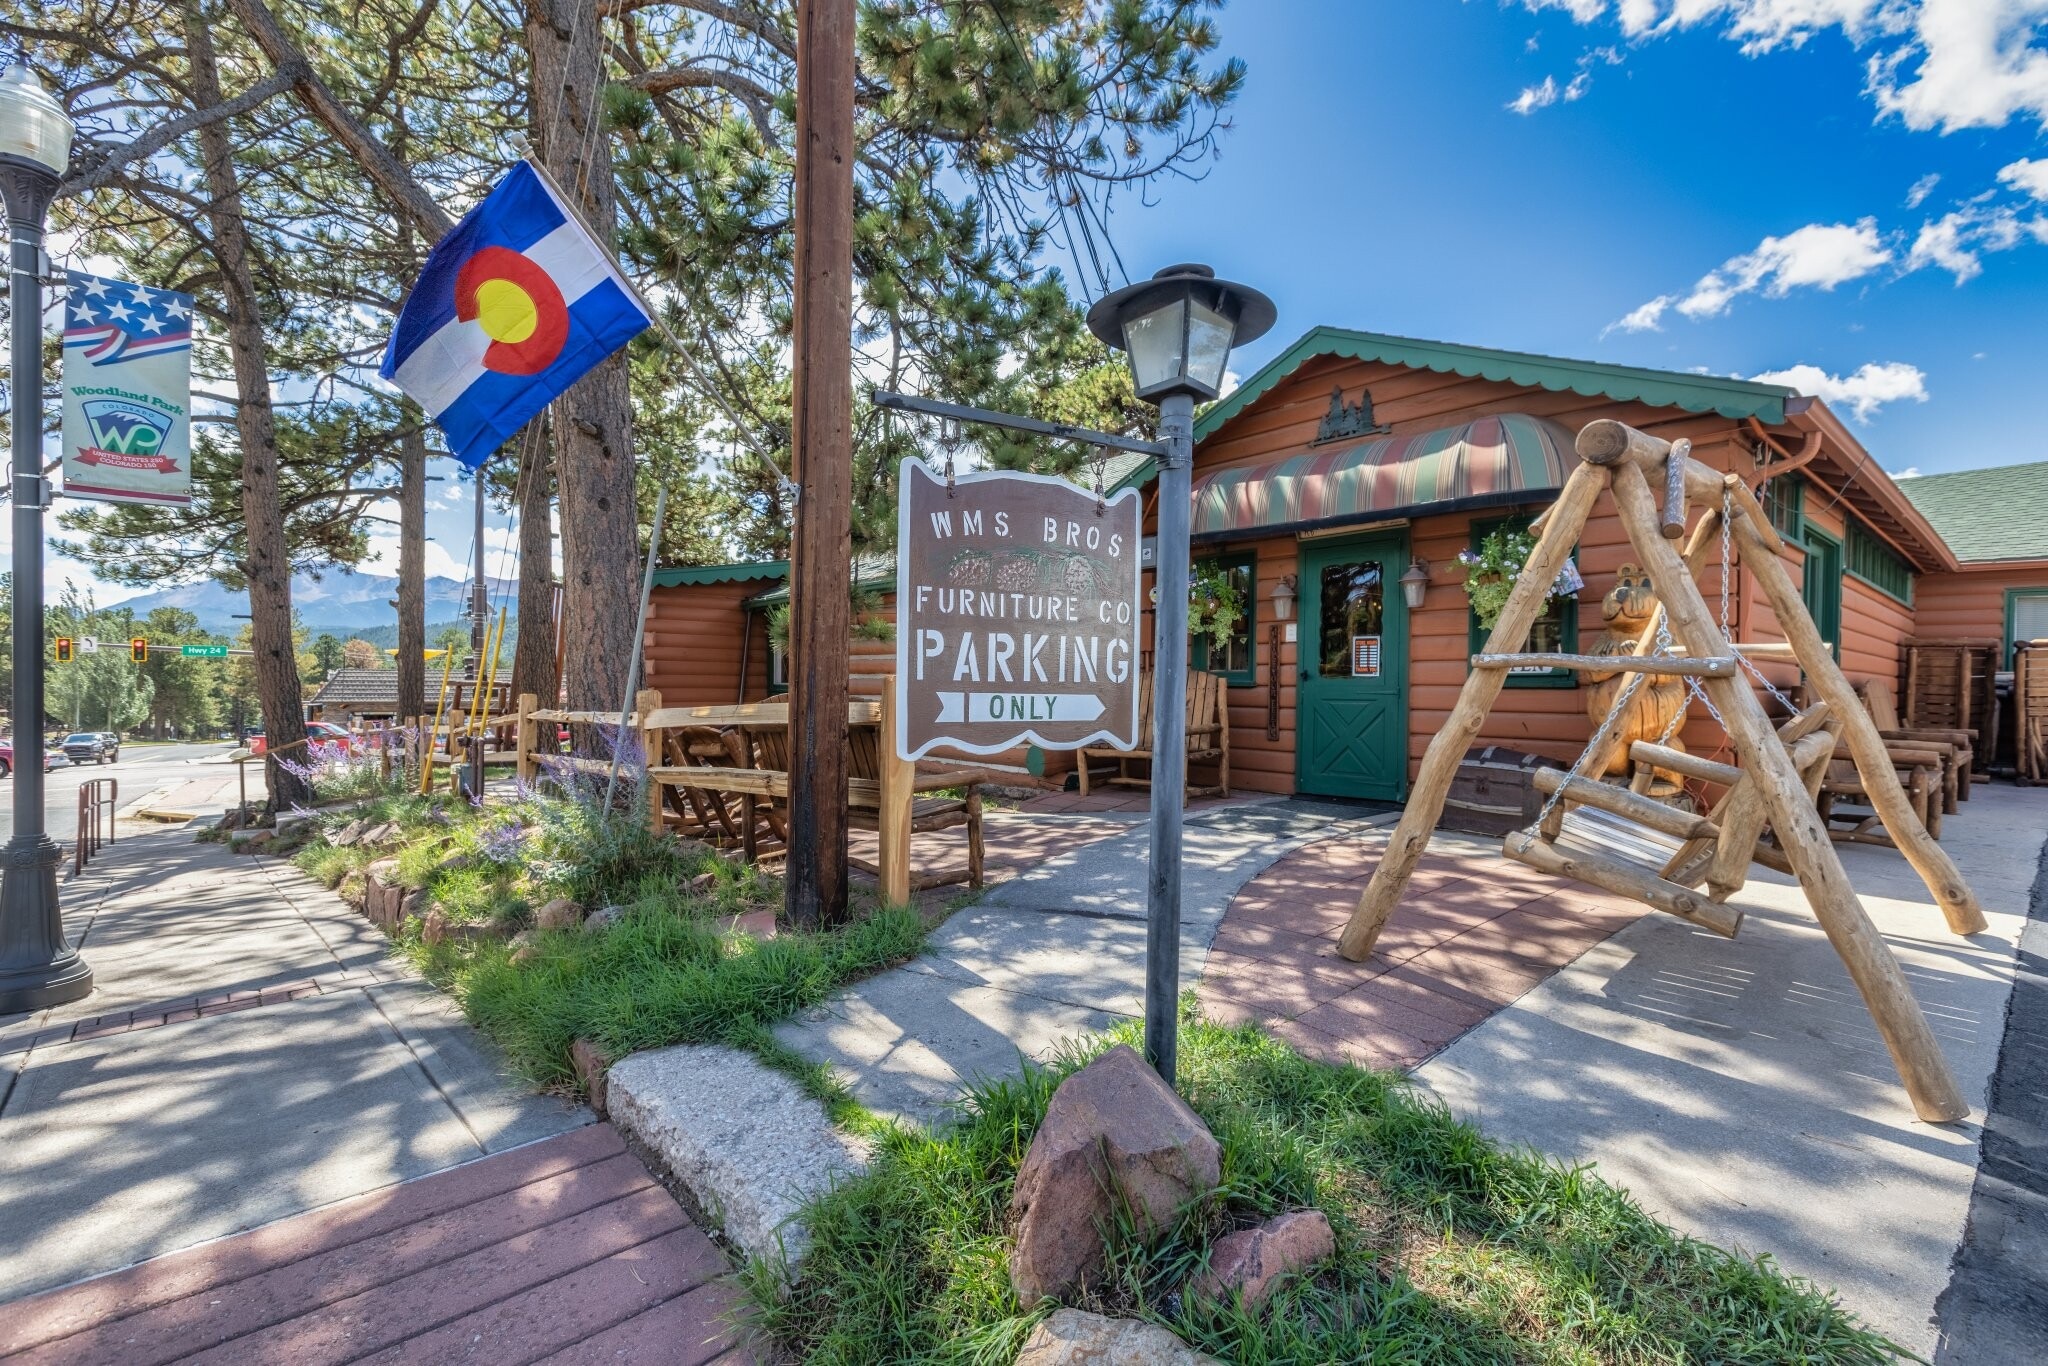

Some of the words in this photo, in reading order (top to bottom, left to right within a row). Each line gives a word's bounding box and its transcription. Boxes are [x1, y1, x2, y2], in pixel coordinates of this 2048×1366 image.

[71, 386, 149, 402] Woodland
[152, 397, 184, 415] Park
[102, 404, 155, 418] COLORADO
[93, 451, 121, 460] UNITED
[122, 455, 149, 463] STATES
[99, 457, 142, 467] COLORADO
[916, 585, 1078, 621] FURNITURE
[188, 647, 207, 655] Hwy
[916, 629, 1129, 683] PARKING
[989, 694, 1058, 720] ONLY
